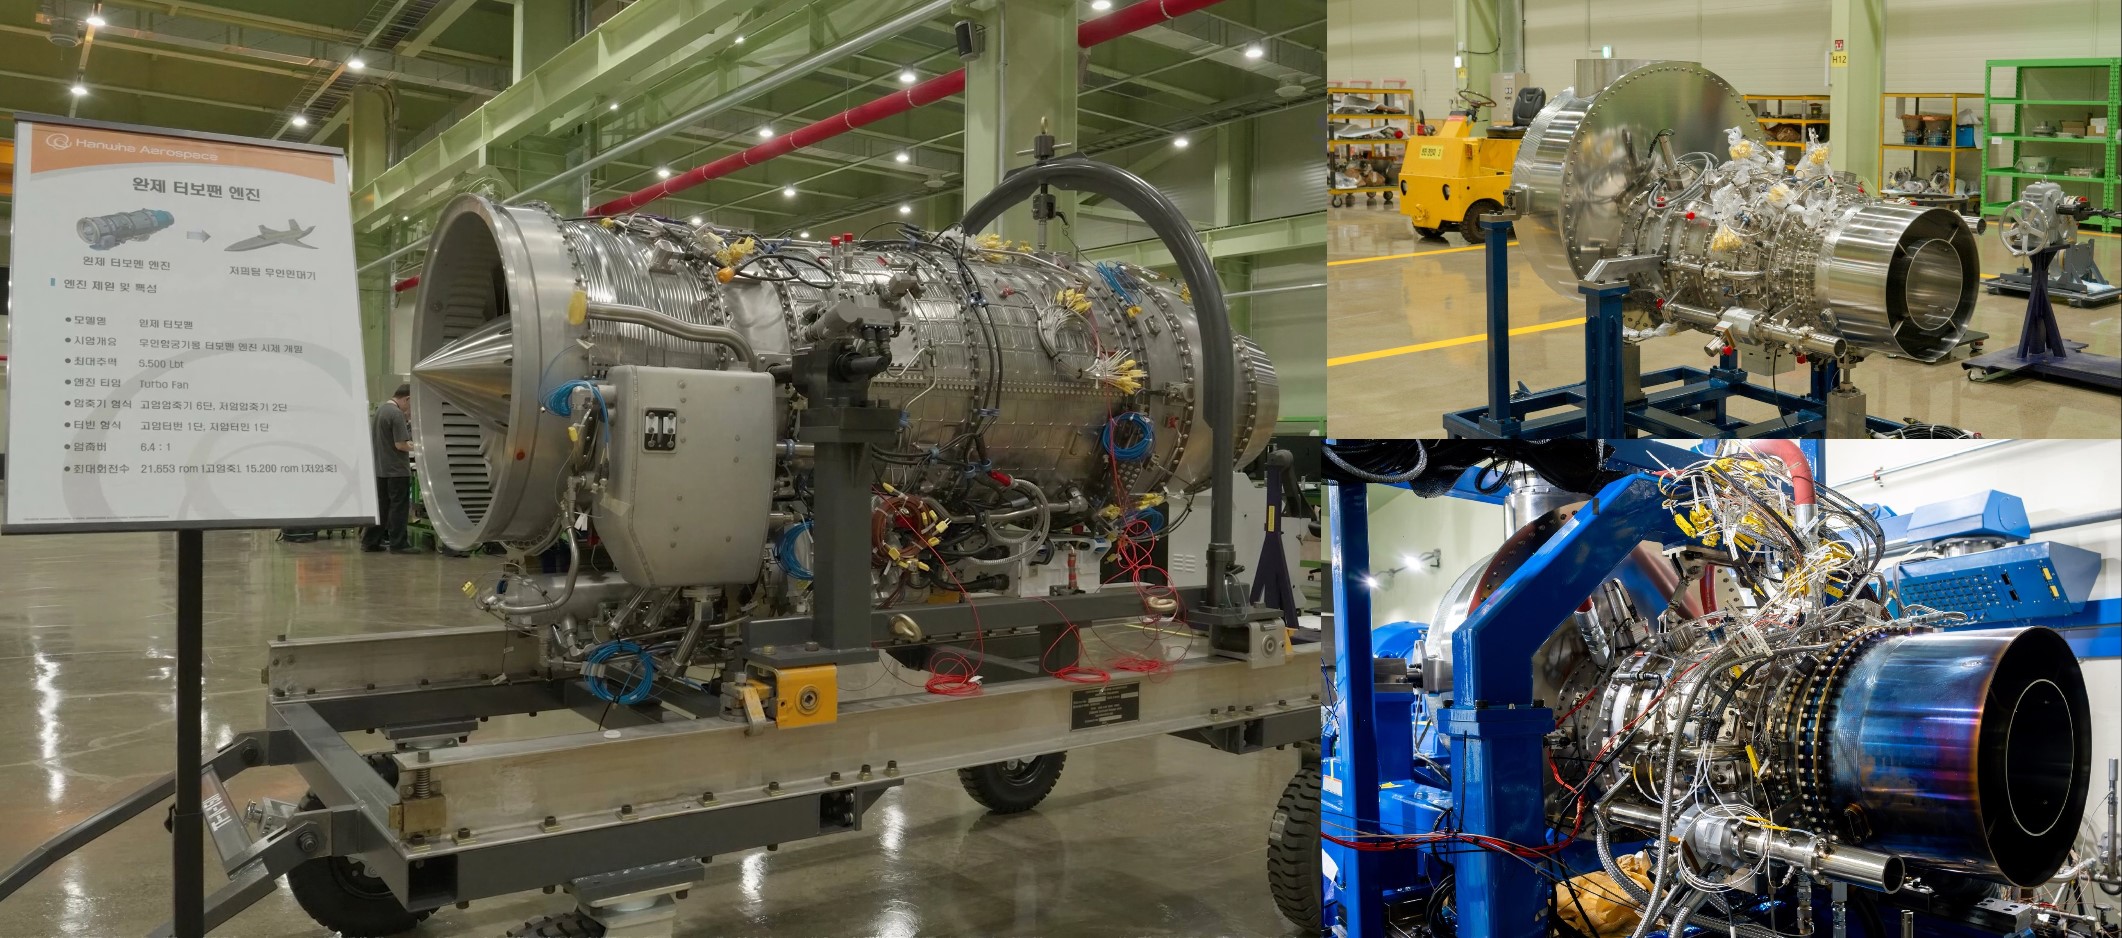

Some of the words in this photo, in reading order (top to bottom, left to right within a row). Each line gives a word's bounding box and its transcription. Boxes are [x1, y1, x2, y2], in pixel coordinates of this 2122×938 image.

[1832, 55, 1847, 64] H12
[76, 138, 136, 153] Hanwha
[139, 145, 218, 161] Aerospace
[132, 177, 166, 194] 완제
[173, 181, 223, 199] 터보팬
[229, 186, 261, 202] 엔진
[148, 260, 171, 271] 엔진
[64, 278, 87, 290] 엔진
[140, 379, 169, 389] Turbo
[171, 380, 189, 390] Fan
[140, 442, 156, 452] 6.4
